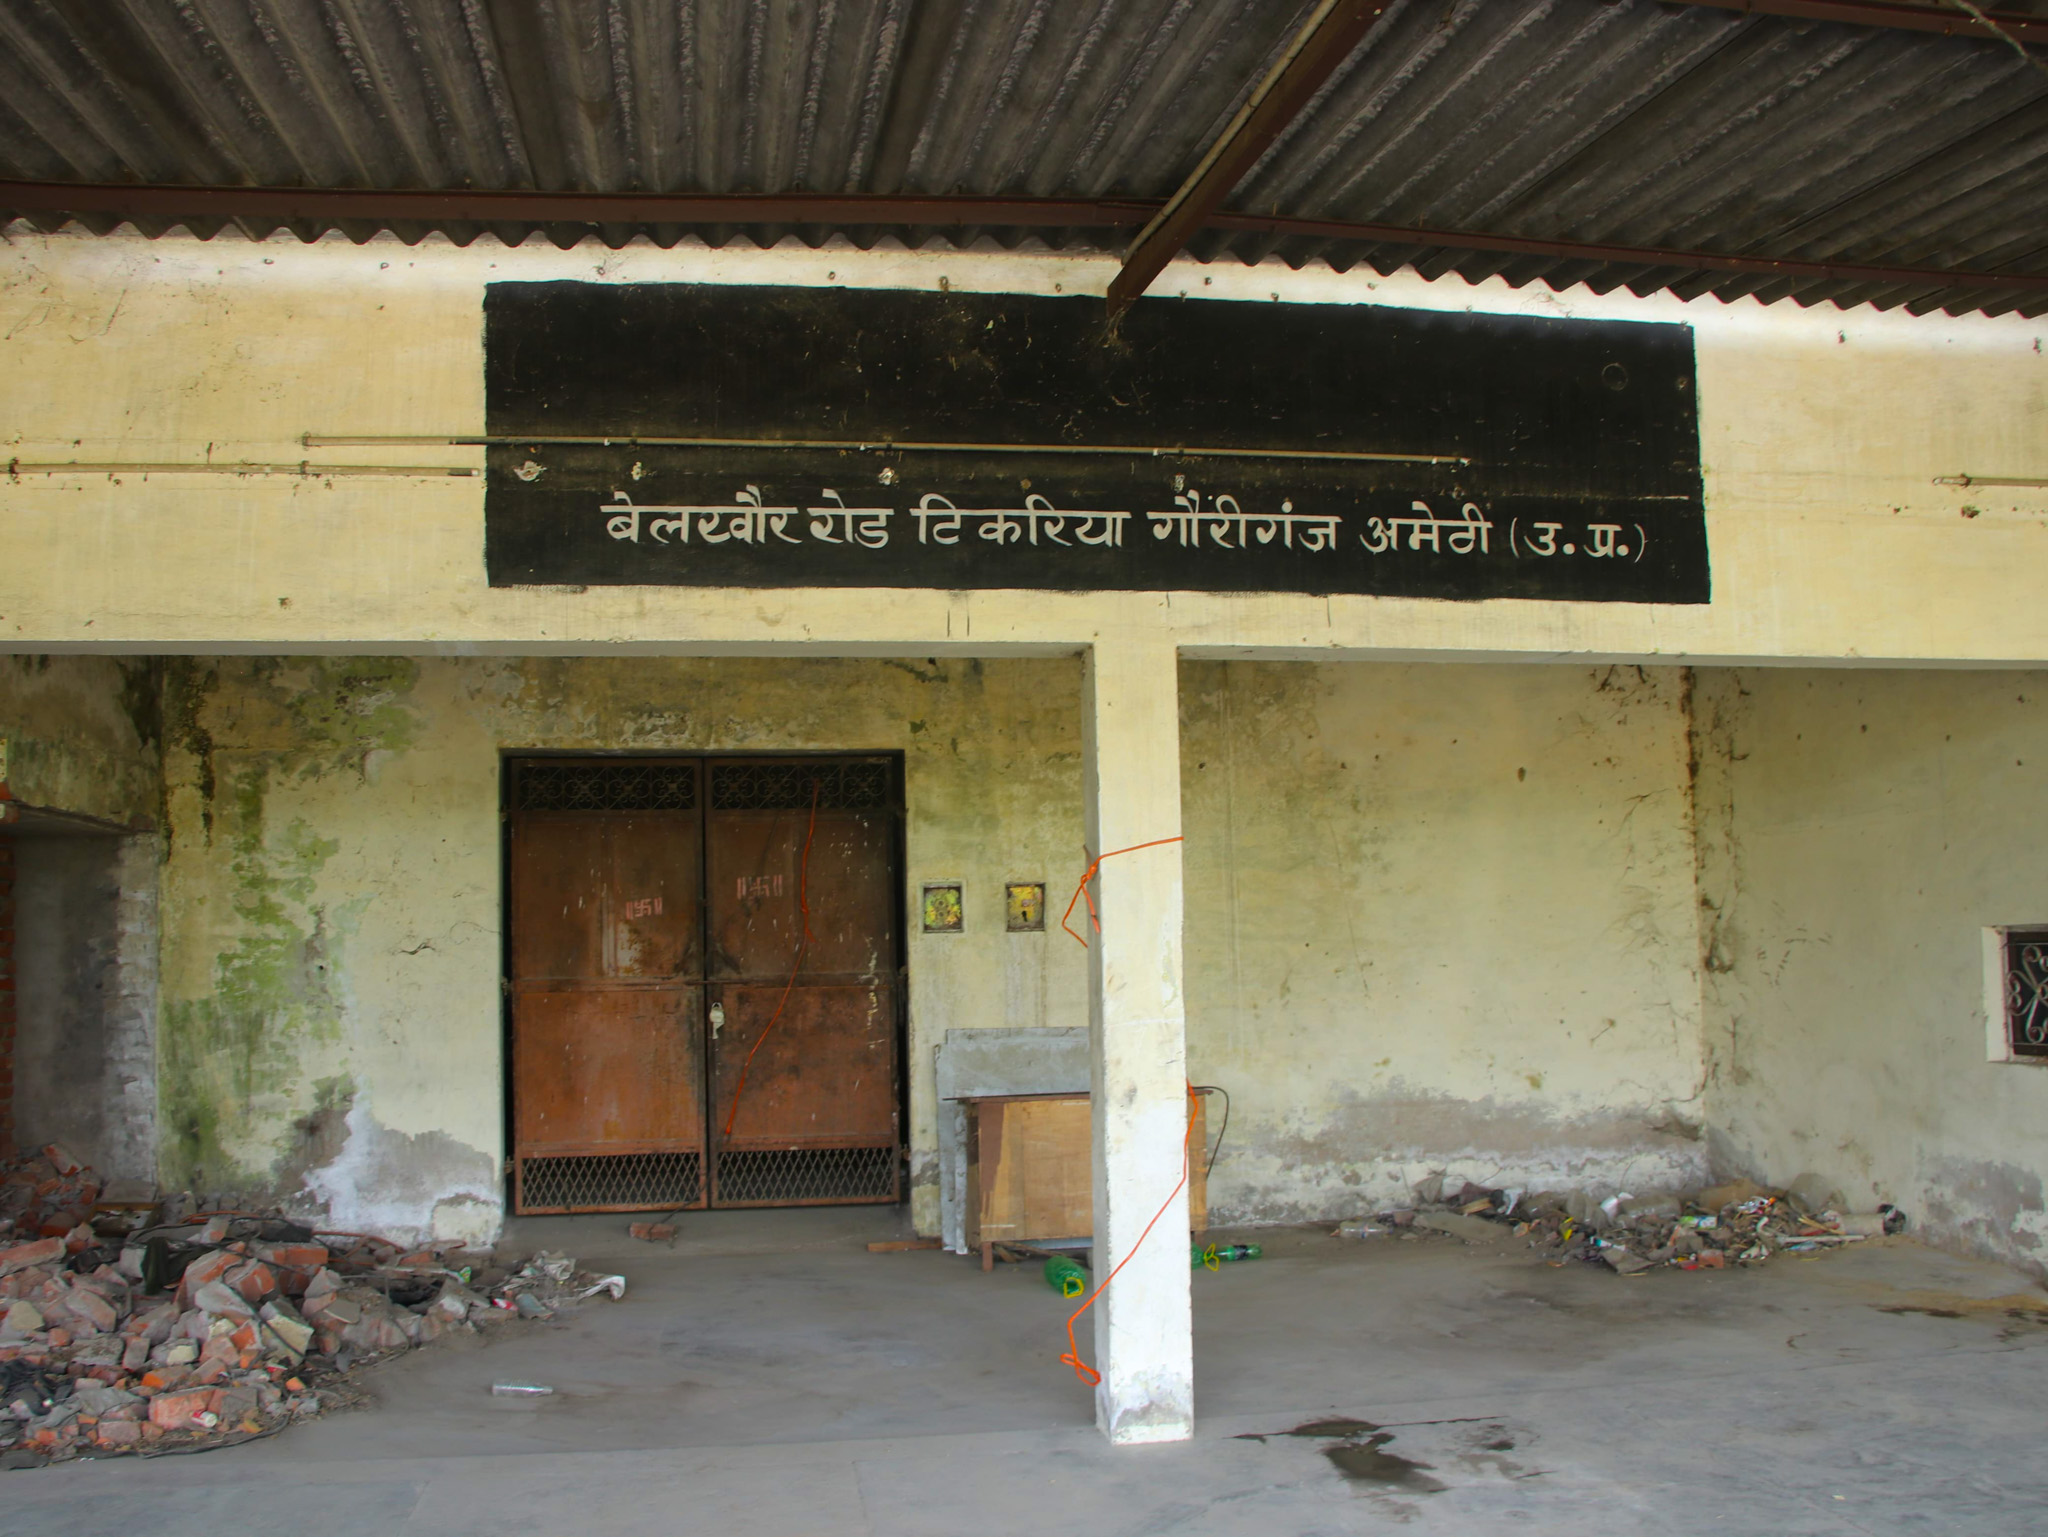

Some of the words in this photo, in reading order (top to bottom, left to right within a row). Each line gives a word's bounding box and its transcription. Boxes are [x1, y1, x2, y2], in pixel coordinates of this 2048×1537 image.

[600, 484, 803, 544] बेलखौर
[807, 489, 895, 549] रोड
[909, 493, 1131, 547] टिकरिया
[1146, 489, 1342, 553] गौरीगंज
[1359, 500, 1494, 555] अमेठी
